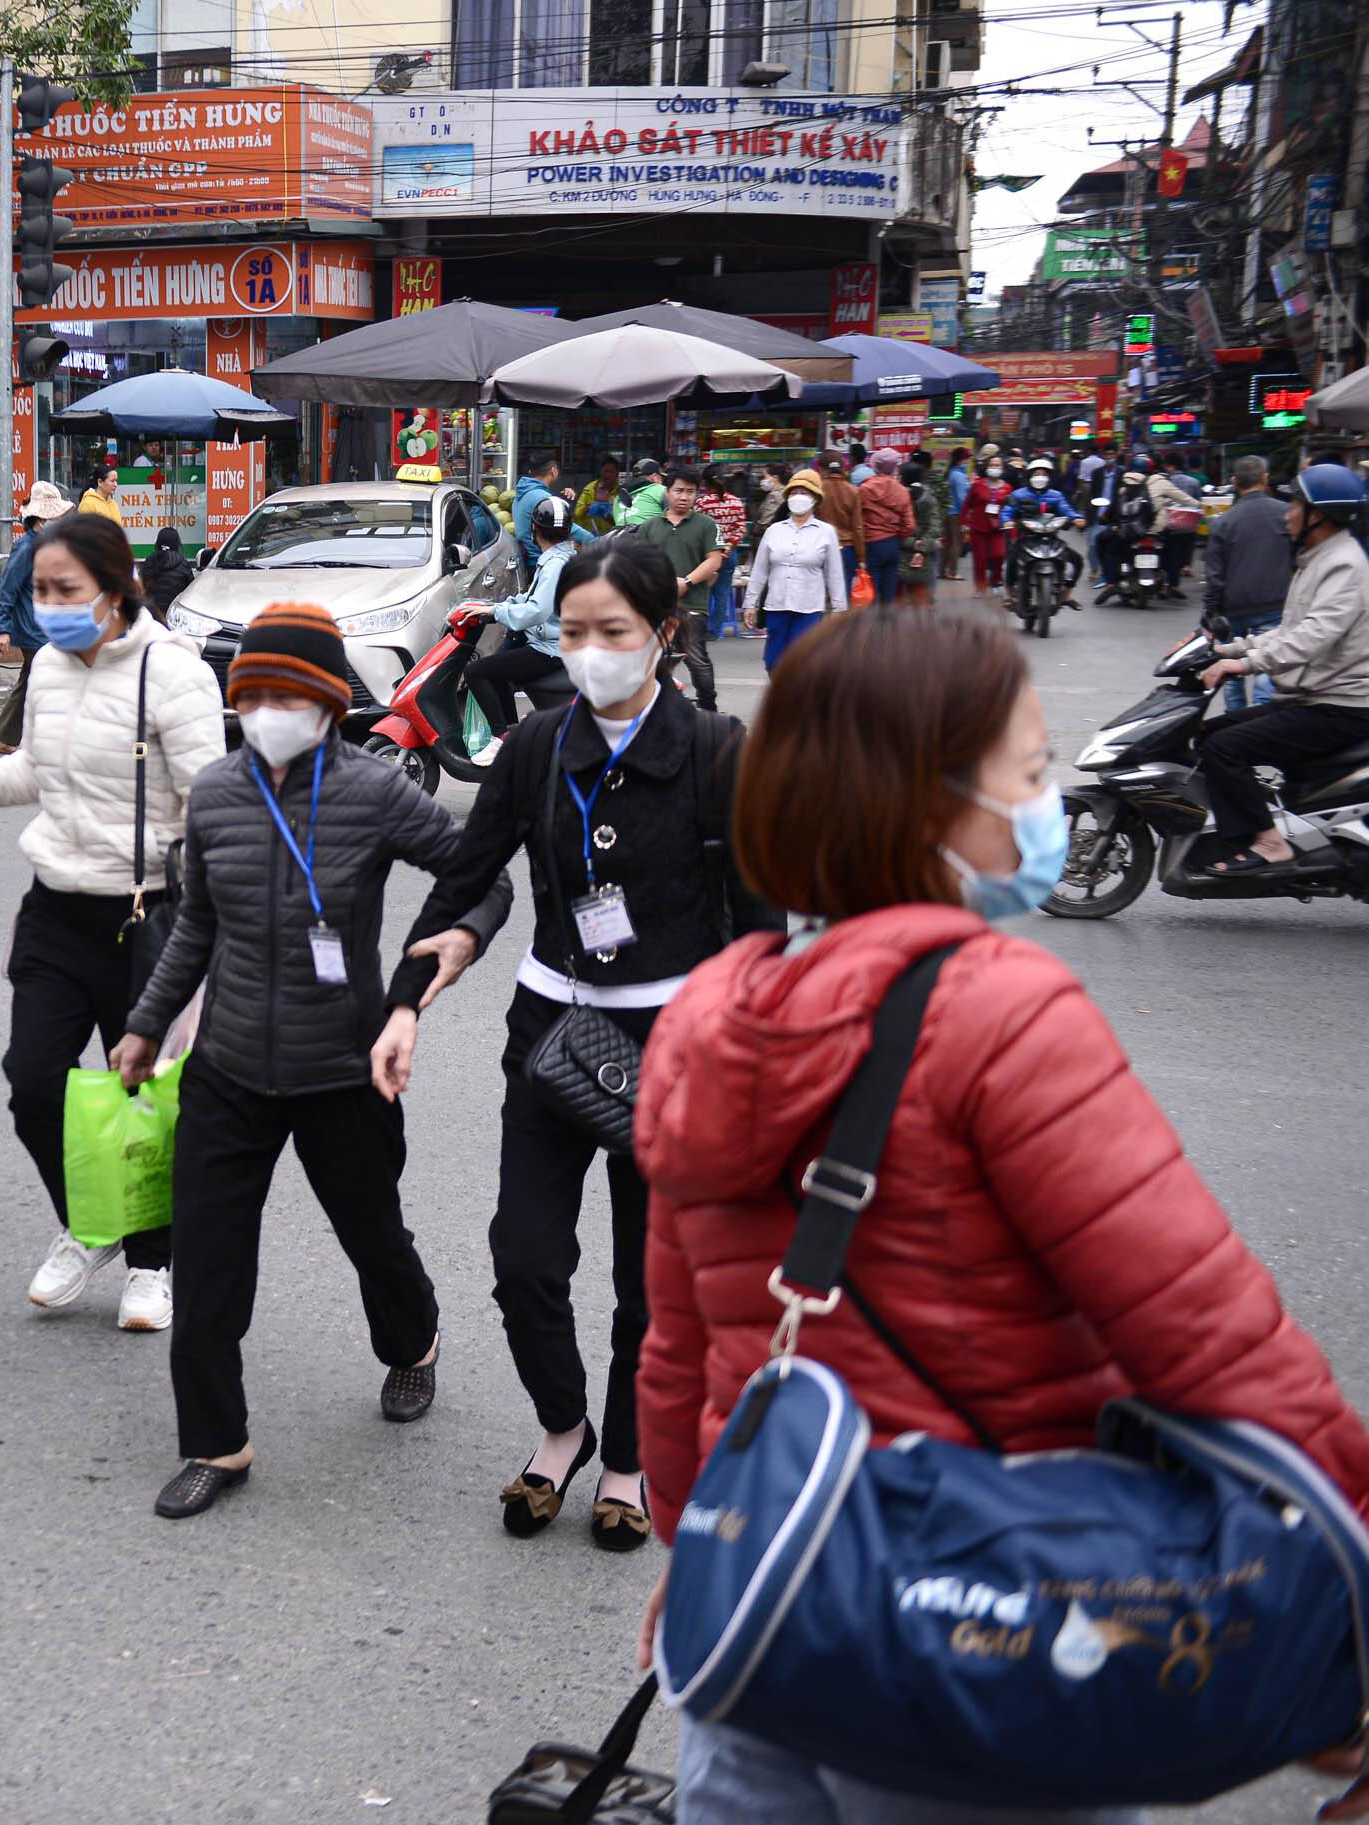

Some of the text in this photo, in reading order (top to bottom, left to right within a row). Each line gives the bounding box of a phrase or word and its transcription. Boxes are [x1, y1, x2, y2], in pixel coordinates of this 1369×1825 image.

[135, 99, 197, 132] TIẾN
[205, 100, 282, 128] HƯNG
[656, 95, 718, 113] CÔNG
[760, 100, 814, 116] TNHH
[132, 136, 172, 154] THUỐC
[174, 136, 191, 152] VÀ
[194, 136, 234, 150] THÀNH
[238, 129, 272, 148] PHẨM
[530, 120, 627, 156] KHẢO
[638, 121, 703, 155] SÁT
[527, 165, 602, 184] POWER
[609, 165, 766, 184] INVESTIGATION
[772, 167, 806, 185] AND
[249, 253, 273, 275] SỐ
[112, 251, 225, 308] TIẾN HƯNG
[246, 279, 275, 304] 1A
[216, 347, 241, 373] NHÀ
[212, 468, 244, 490] HƯNG
[404, 467, 431, 478] TAXI
[121, 491, 151, 506] NHÀ
[121, 510, 154, 528] TIẾN
